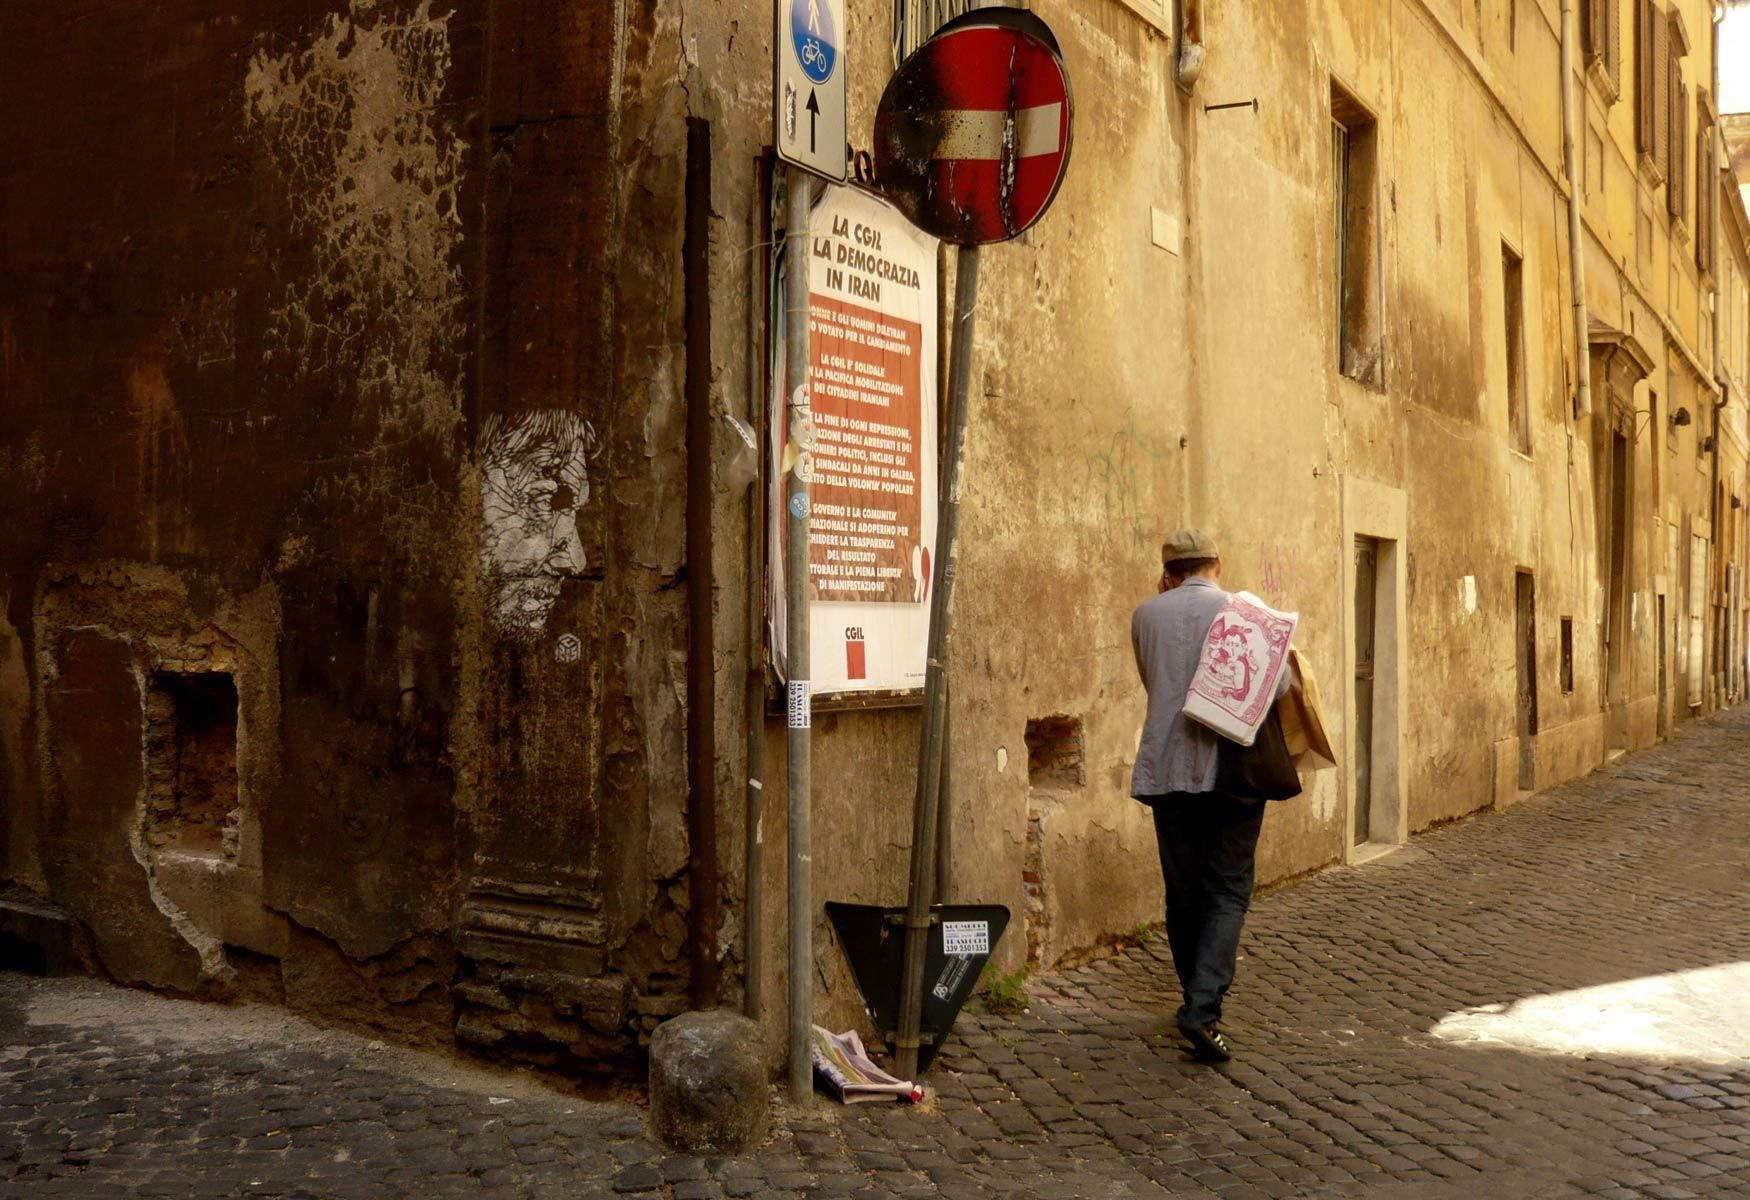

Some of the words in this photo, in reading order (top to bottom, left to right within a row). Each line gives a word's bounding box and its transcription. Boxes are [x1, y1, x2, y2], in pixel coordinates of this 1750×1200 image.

[832, 214, 849, 239] LA
[854, 223, 882, 250] CGIL
[813, 237, 832, 261] LA
[836, 244, 920, 290] DEMOCRAZIA
[826, 268, 842, 290] IN
[848, 274, 880, 302] IRAN
[810, 305, 830, 320] ONNE
[832, 312, 836, 322] E
[838, 313, 849, 325] GLI
[850, 316, 876, 332] UOMINI
[818, 322, 844, 338] VOTATO
[846, 330, 858, 342] PER
[859, 333, 866, 345] IL
[866, 336, 910, 356] CAMBIAMENTO
[820, 354, 830, 365] LA
[830, 356, 846, 369] CGIL
[854, 361, 884, 378] SOLIDALE
[814, 367, 824, 380] LA
[824, 369, 854, 386] PACIFICA
[855, 376, 904, 396] MOBILITAZIONE
[814, 382, 826, 395] DEI
[826, 384, 859, 401] CITTADINI
[860, 391, 890, 407] IRANIANI
[814, 412, 823, 424] LA
[824, 414, 840, 426] FINE
[840, 416, 848, 428] DI
[850, 418, 868, 432] OGNI
[811, 442, 836, 456] IONIERI
[838, 446, 868, 463] POLITICI,
[870, 451, 894, 464] INCLUSI
[895, 456, 906, 466] GLI
[842, 432, 862, 446] DEGLI
[864, 435, 896, 450] ARRESTATI
[896, 442, 900, 452] E
[902, 442, 912, 454] DEI
[816, 458, 850, 472] SINDACALI
[852, 463, 862, 474] DA
[862, 465, 880, 477] ANNI
[882, 467, 890, 478] IN
[826, 474, 848, 487] DELLA
[882, 482, 914, 496] POPOLARE
[812, 503, 845, 517] GOVERNO
[846, 506, 850, 518] E
[852, 507, 861, 518] LA
[810, 518, 848, 532] NAZIONALE
[850, 521, 857, 532] SI
[858, 522, 896, 536] ADOPERINO
[896, 526, 909, 537] PER
[840, 536, 848, 546] LA
[850, 536, 895, 550] TRASPARENZA
[827, 549, 840, 561] DEL
[842, 550, 876, 562] RISULTATO
[810, 564, 838, 576] TTORALE
[840, 564, 844, 575] E
[845, 565, 854, 576] LA
[856, 566, 876, 577] PIENA
[820, 579, 828, 590] DI
[828, 580, 885, 592] MANIFESTAZIONE
[845, 626, 864, 640] CGIL
[946, 944, 958, 952] 339
[959, 944, 987, 952] 2501353
